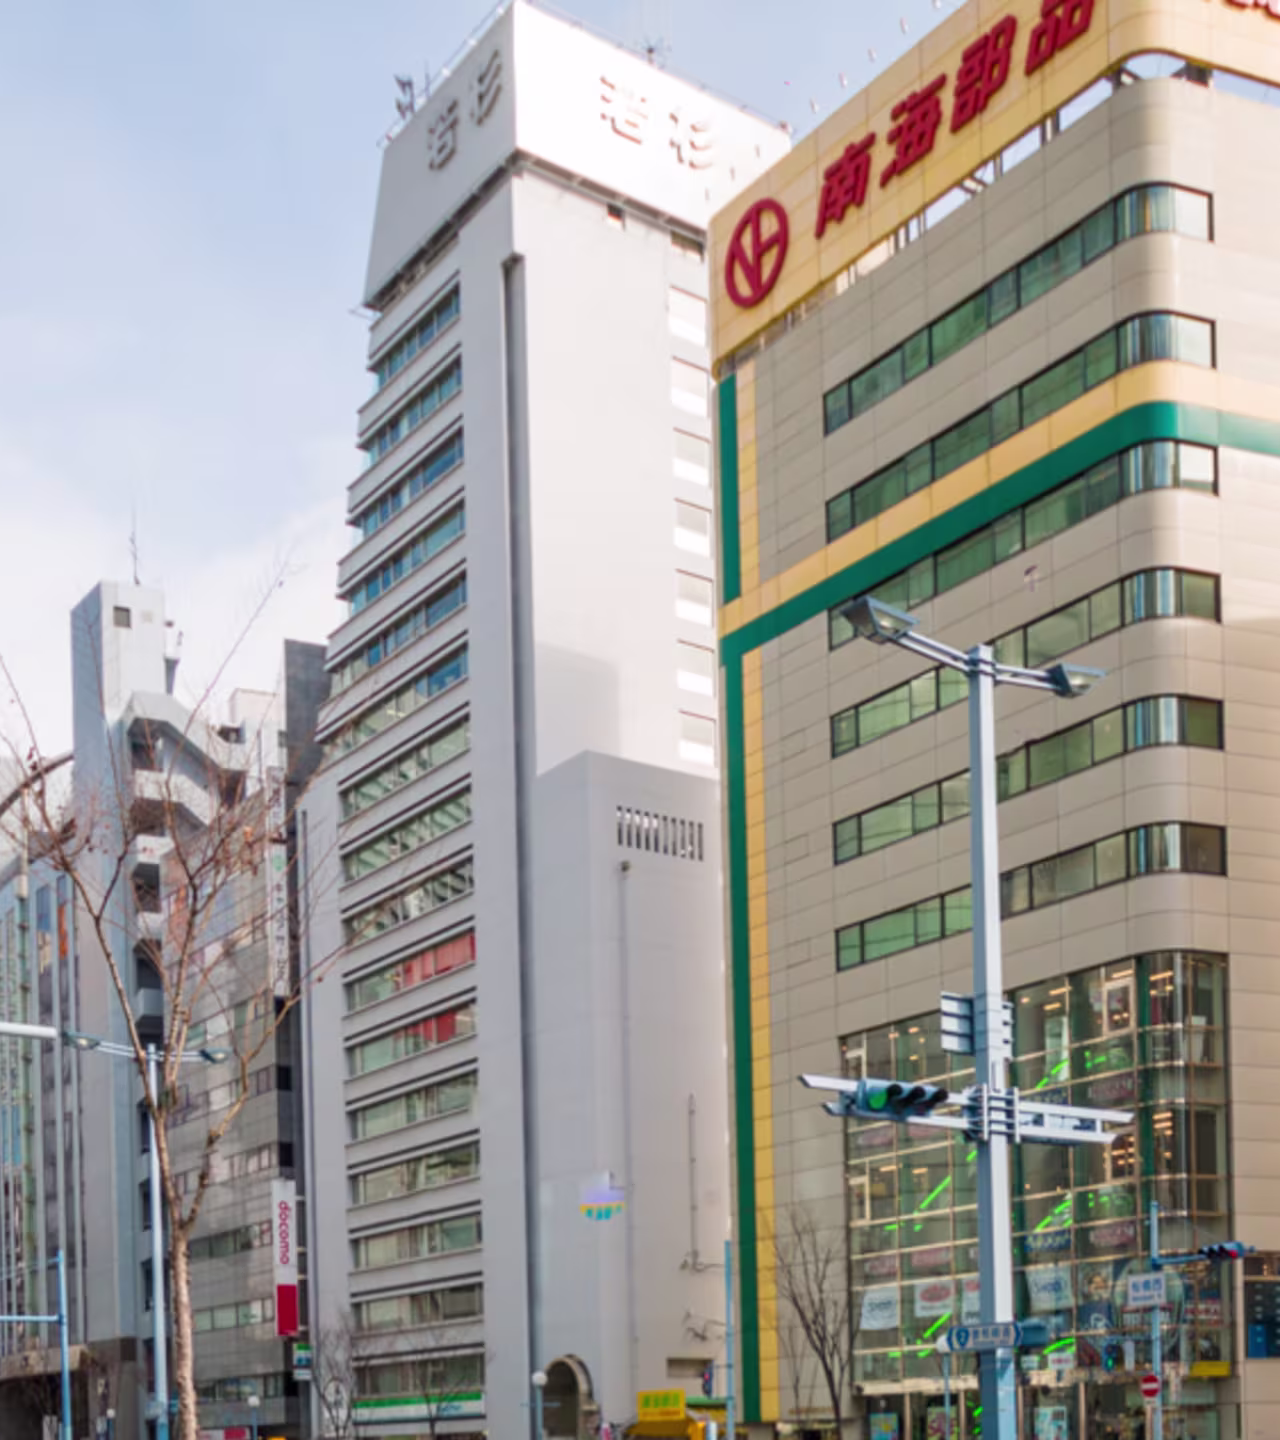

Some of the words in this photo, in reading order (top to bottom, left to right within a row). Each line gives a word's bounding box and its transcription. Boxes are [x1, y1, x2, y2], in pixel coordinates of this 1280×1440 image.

[814, 0, 1098, 240] 南海部品
[279, 1199, 291, 1265] docomo
